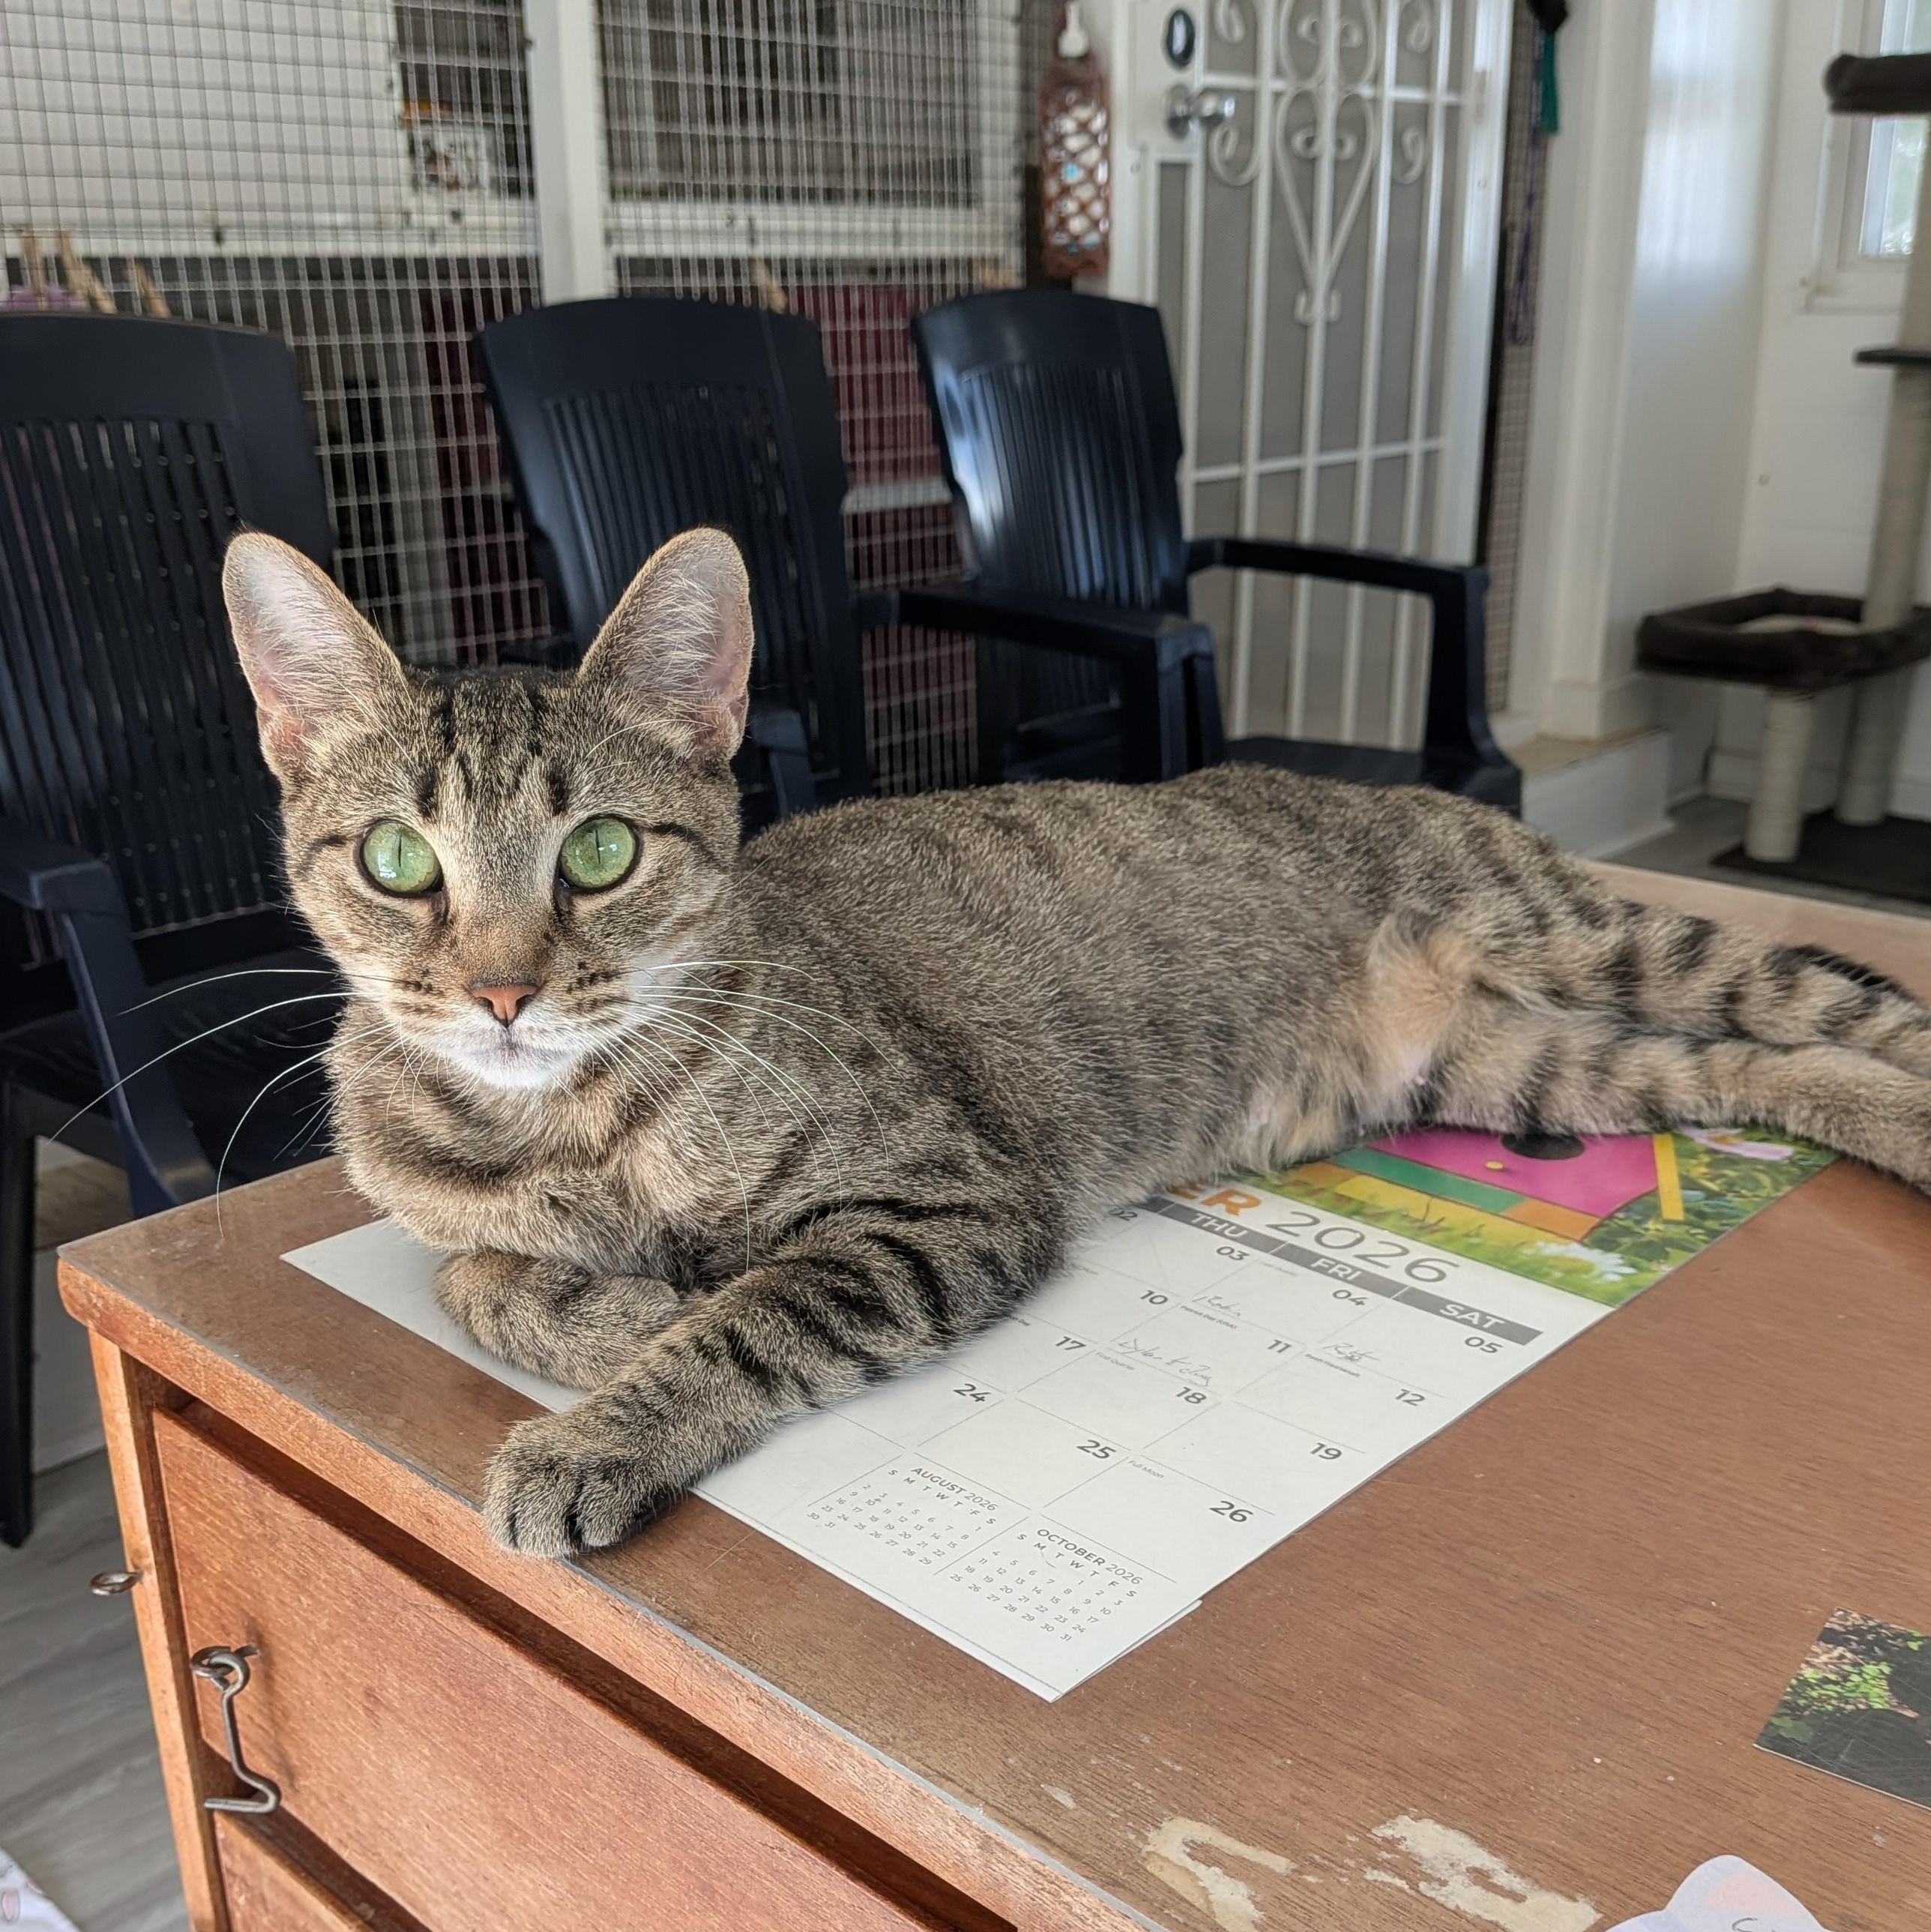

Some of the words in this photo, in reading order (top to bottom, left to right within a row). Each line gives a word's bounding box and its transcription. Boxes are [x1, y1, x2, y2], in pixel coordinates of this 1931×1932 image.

[1216, 1246, 1250, 1261] 03
[1265, 1211, 1460, 1283] 2026
[1190, 1212, 1248, 1238] THU
[1310, 1258, 1362, 1281] FRI
[1439, 1303, 1505, 1329] SAT
[1139, 1289, 1169, 1305] 10
[1332, 1289, 1368, 1306] 04
[1055, 1336, 1087, 1351] 17
[1267, 1339, 1292, 1354] 11
[1464, 1336, 1503, 1354] 05
[952, 1382, 992, 1403] 24
[1175, 1386, 1208, 1404] 18
[1394, 1388, 1426, 1407] 12
[1076, 1439, 1117, 1459] 25
[1310, 1442, 1343, 1460] 19
[1127, 1460, 1143, 1469] Full
[1141, 1466, 1165, 1479] Moon
[911, 1467, 967, 1493] AUGUST
[963, 1492, 998, 1511] 2026
[936, 1492, 950, 1500] W
[807, 1511, 820, 1520] 30
[1208, 1500, 1254, 1523] 26
[837, 1513, 849, 1521] 24
[853, 1522, 867, 1530] 25
[902, 1548, 916, 1556] 28
[918, 1556, 932, 1565] 29
[897, 1515, 908, 1523] 12
[947, 1541, 958, 1549] 15
[898, 1531, 912, 1539] 20
[932, 1548, 945, 1557] 22
[1033, 1542, 1047, 1550] M
[1070, 1559, 1085, 1569] W
[1037, 1529, 1106, 1566] OCTOBER
[1105, 1563, 1143, 1586] 2026
[964, 1565, 976, 1574] 18
[983, 1575, 994, 1583] 19
[999, 1585, 1013, 1594] 20
[1018, 1595, 1030, 1603] 21
[1034, 1604, 1049, 1613] 22
[1054, 1614, 1068, 1623] 23
[1071, 1624, 1086, 1633] 24
[996, 1567, 1007, 1575] 12
[1014, 1577, 1025, 1585] 13
[1031, 1586, 1043, 1595] 14
[1049, 1595, 1061, 1604] 15
[1069, 1606, 1080, 1614] 16
[949, 1573, 963, 1582] 25
[968, 1583, 982, 1592] 26
[986, 1594, 1001, 1602] 27
[1003, 1603, 1017, 1613] 28
[1021, 1613, 1035, 1622] 29
[1040, 1622, 1055, 1632] 30
[1059, 1633, 1073, 1641] 31
[1100, 1607, 1112, 1615] 10
